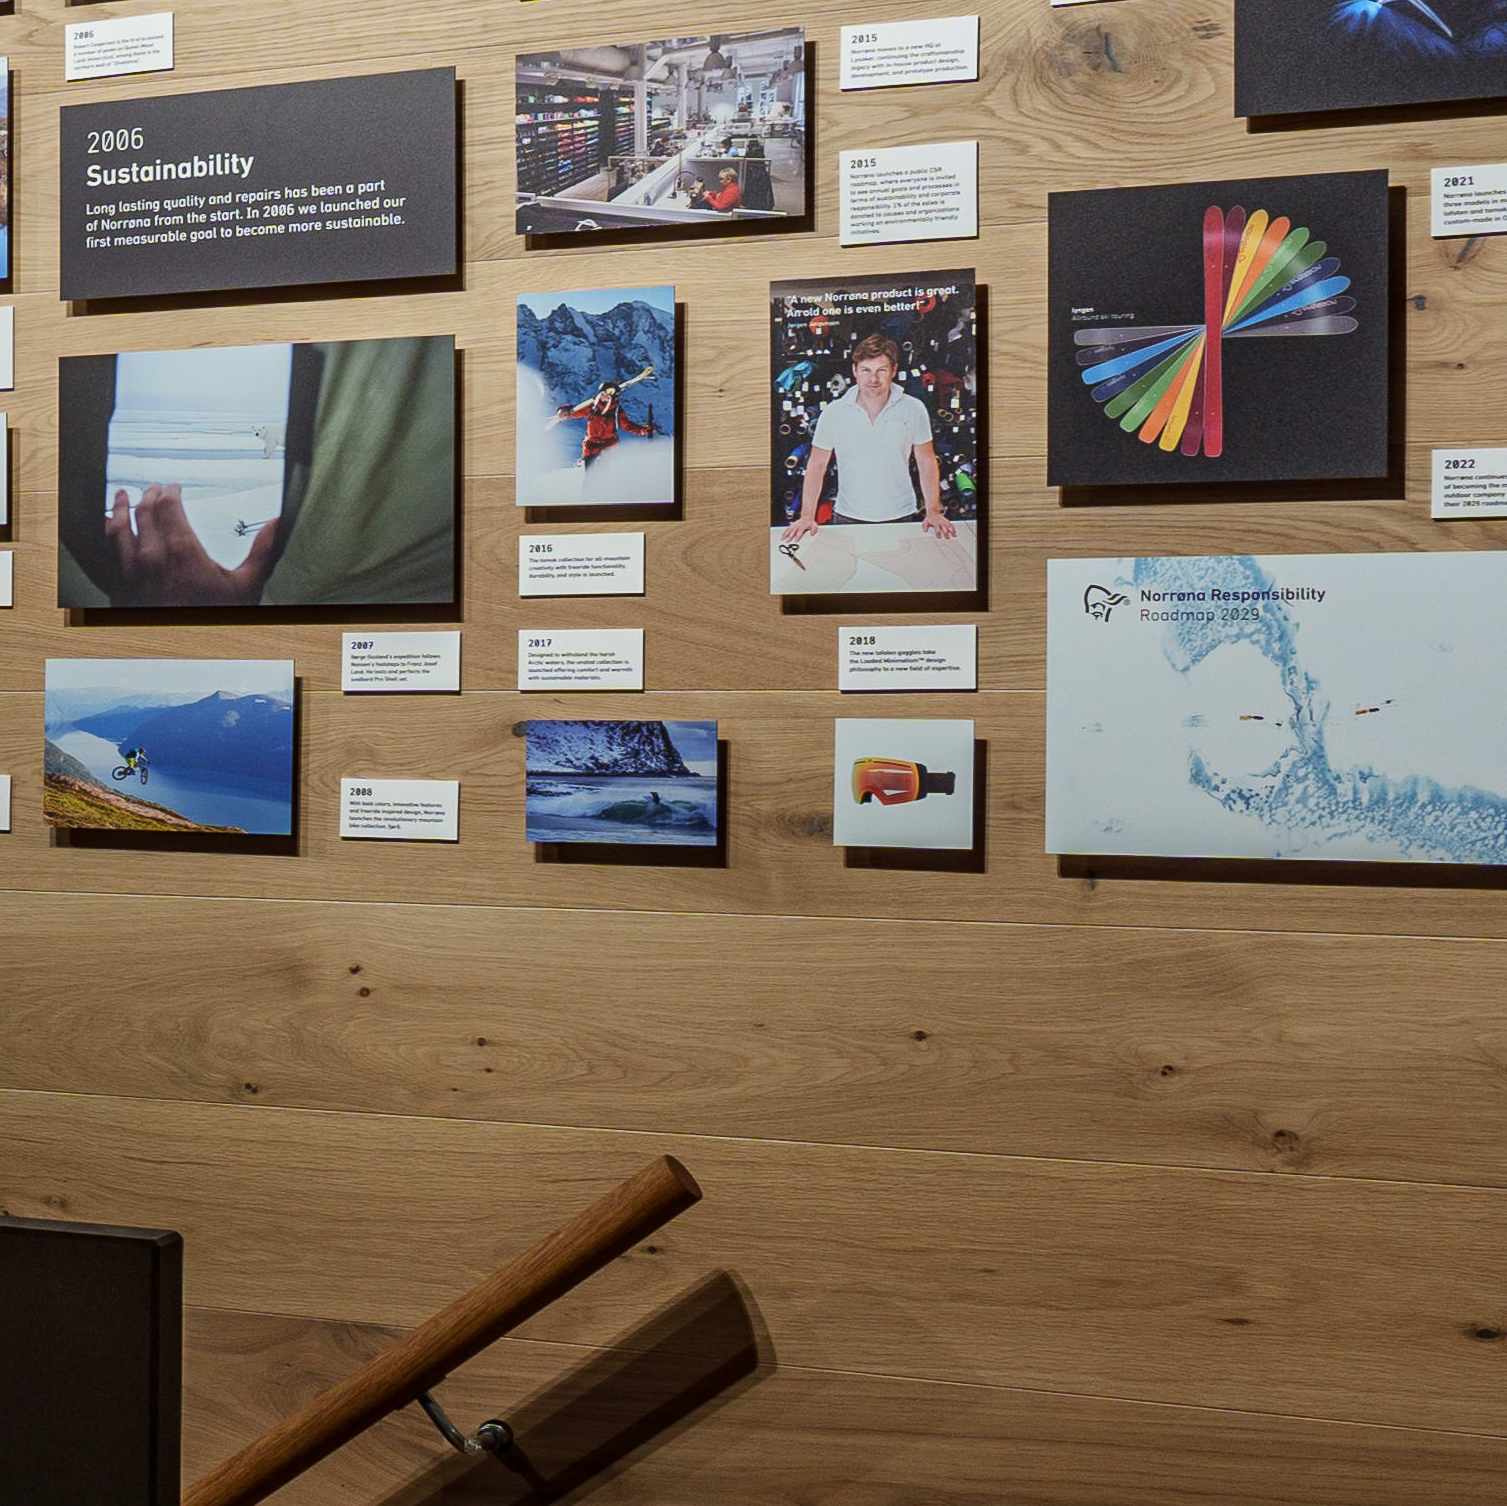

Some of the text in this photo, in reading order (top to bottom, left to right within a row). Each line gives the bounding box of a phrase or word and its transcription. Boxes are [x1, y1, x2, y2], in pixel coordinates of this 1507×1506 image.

[851, 33, 878, 44] 2015
[87, 128, 144, 154] 2006
[86, 153, 254, 186] Sustainability
[850, 157, 876, 169] 2015
[1443, 175, 1474, 187] 2021
[86, 180, 385, 216] Long lasting quality and repairs has been a part
[86, 197, 406, 232] of Norrøna from the start. In 2006 we launched our
[86, 213, 405, 248] first measurable goal to become more sustainable.
[800, 295, 822, 304] new
[870, 289, 912, 301] product
[915, 287, 924, 296] is
[927, 285, 959, 297] great.
[822, 306, 841, 316] one
[844, 303, 853, 314] is
[856, 305, 882, 314] even
[1444, 458, 1475, 470] 2022
[528, 543, 552, 553] 2016
[1140, 587, 1326, 603] Norrøna Responsibility
[1140, 607, 1259, 624] Roadmap 2029
[527, 638, 552, 647] 2017
[848, 635, 875, 645] 2018
